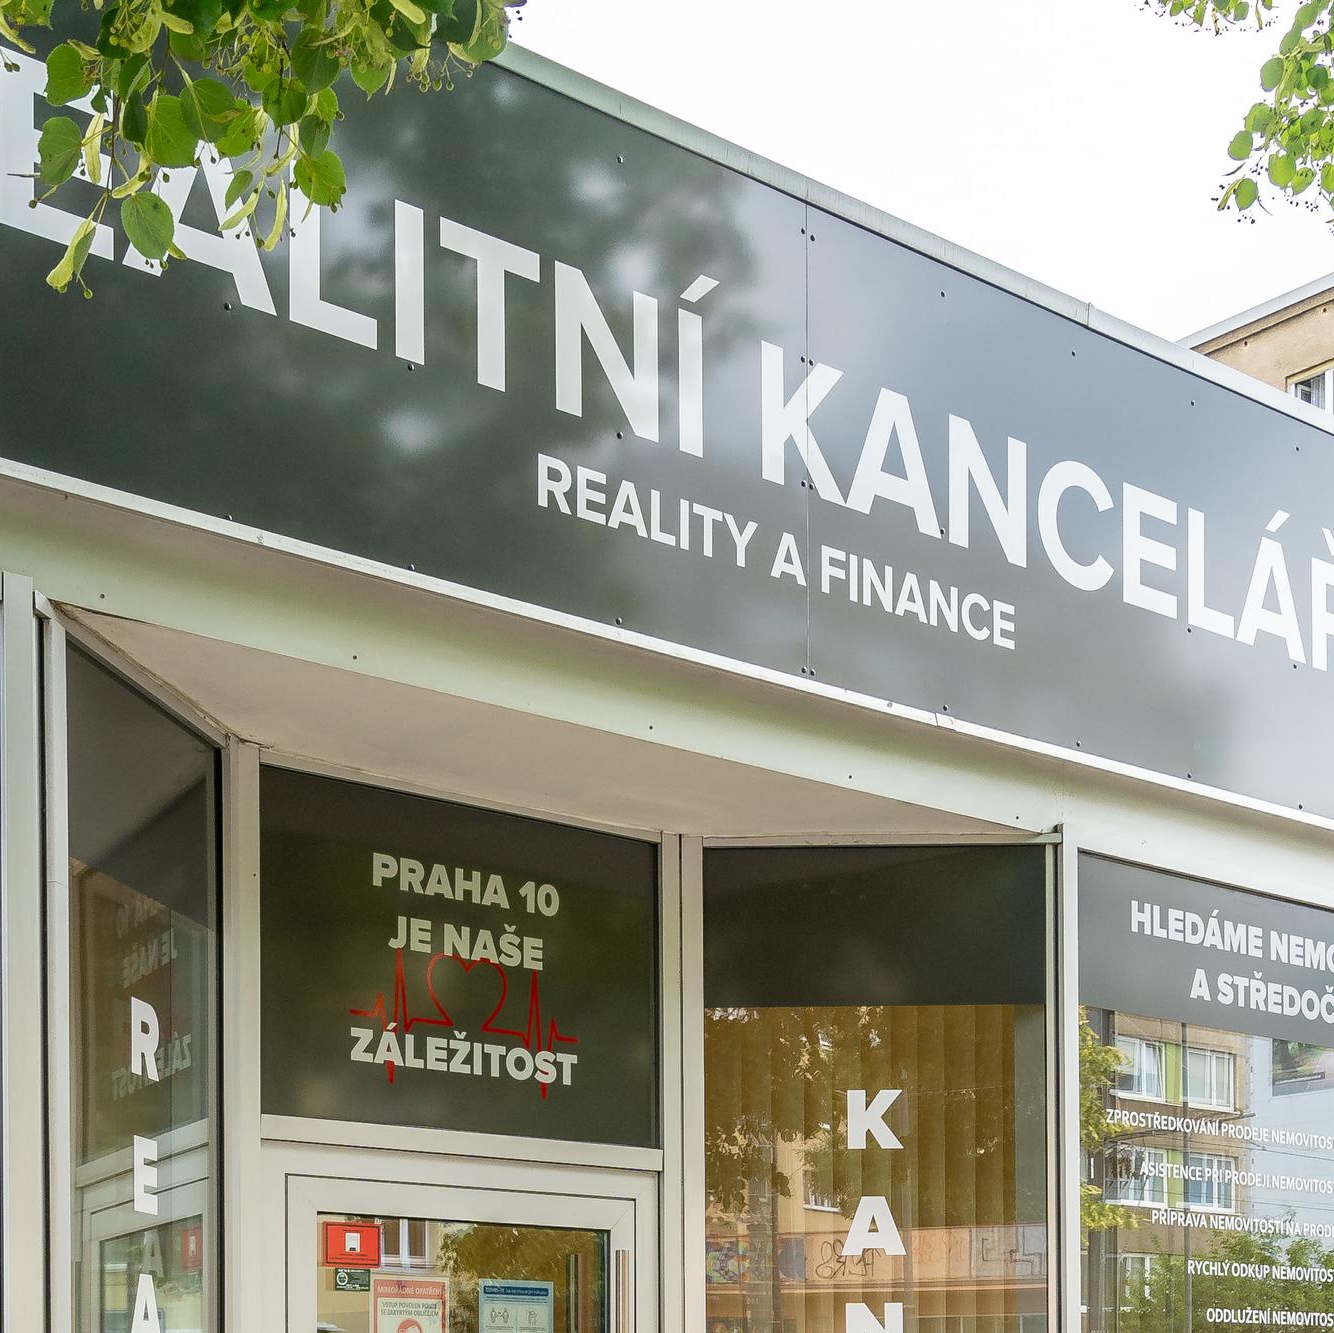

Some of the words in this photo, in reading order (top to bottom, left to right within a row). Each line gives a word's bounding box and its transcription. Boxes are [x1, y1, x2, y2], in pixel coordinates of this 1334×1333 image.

[538, 451, 759, 569] REALITY
[770, 533, 806, 587] A
[821, 544, 1016, 651] FINANCE
[372, 852, 510, 909] PRAHA
[519, 881, 560, 917] 10
[387, 915, 432, 954] JE
[444, 924, 543, 971] NAŠE
[1131, 900, 1263, 958] HLEDÁME
[1190, 968, 1211, 1001] A
[349, 1022, 578, 1086] ZÁLEŽITOST
[1106, 1108, 1219, 1135] ZPROSTŘEDKOVÁNÍ
[1221, 1123, 1269, 1142] PRODEJE
[1140, 1161, 1203, 1181] ASISTENCE
[1225, 1169, 1269, 1188] PRODEJI
[1285, 1222, 1300, 1235] NA
[1187, 1259, 1229, 1277] RYCHLÝ
[1231, 1262, 1269, 1279] ODKUP
[1206, 1307, 1270, 1325] ODDLUŽENÍ
